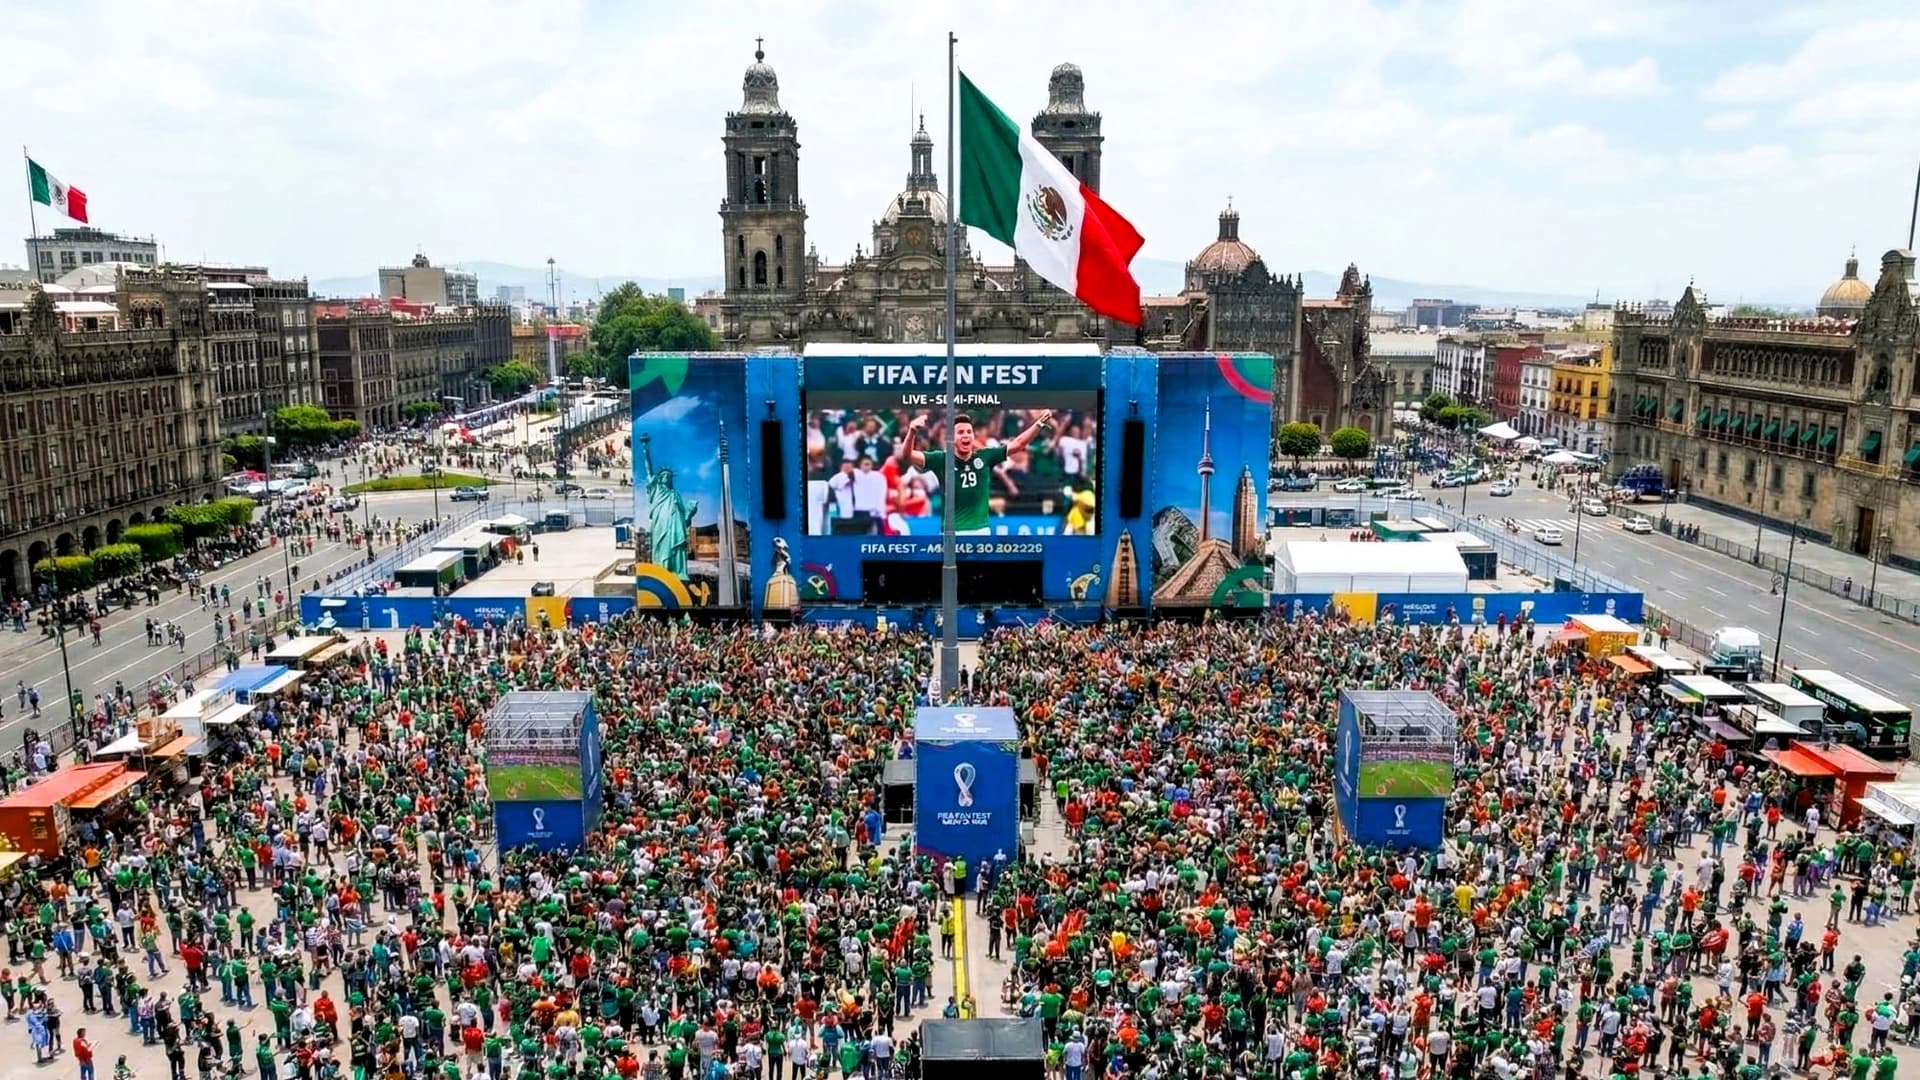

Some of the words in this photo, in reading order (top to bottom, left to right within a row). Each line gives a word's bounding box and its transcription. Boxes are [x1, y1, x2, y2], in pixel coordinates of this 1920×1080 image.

[863, 365, 917, 385] FIFA
[923, 365, 973, 385] FAN
[981, 365, 1043, 385] FEST
[902, 394, 928, 405] LIVE
[960, 471, 977, 489] 29
[861, 543, 886, 554] FIFA
[888, 543, 917, 554] FEST
[976, 543, 993, 554] 30
